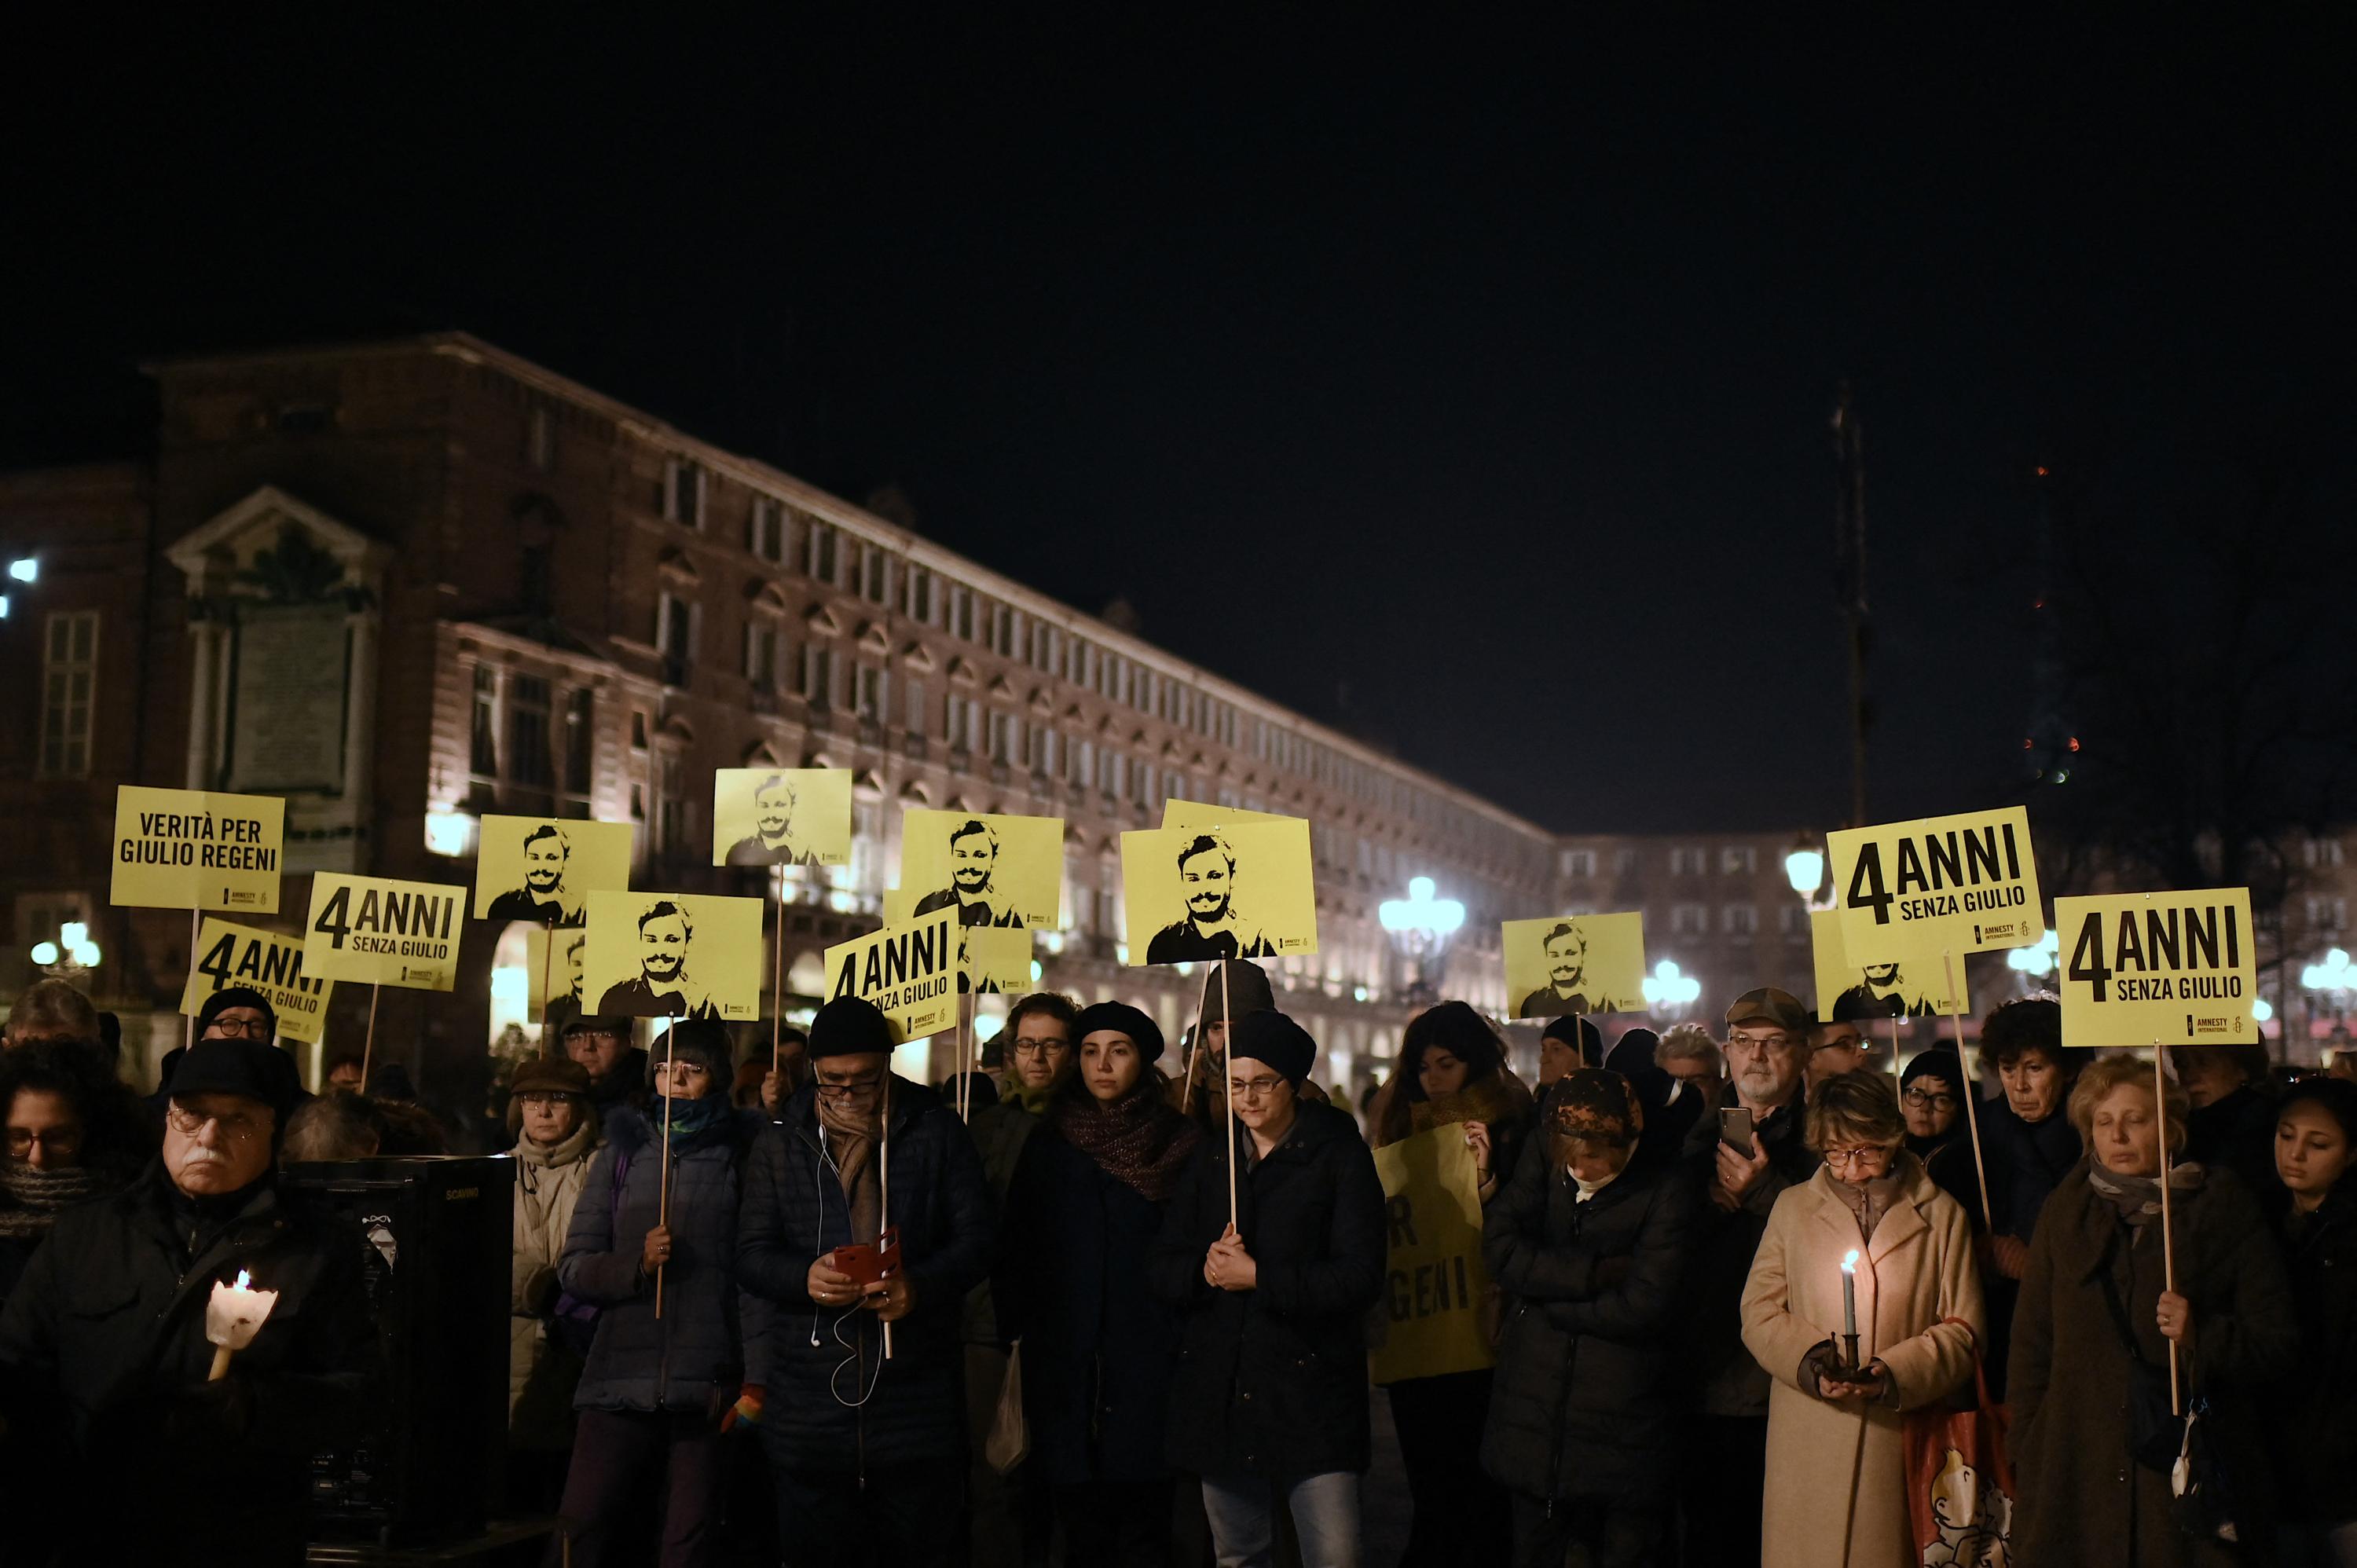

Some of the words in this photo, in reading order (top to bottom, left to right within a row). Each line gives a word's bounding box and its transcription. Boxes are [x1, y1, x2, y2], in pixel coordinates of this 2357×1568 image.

[140, 811, 215, 841] VERITÀ
[221, 819, 261, 844] PER
[120, 839, 193, 866] GIULIO
[200, 844, 276, 871] REGENI
[1846, 841, 1893, 925] 4
[1897, 823, 2022, 896] ANNI
[314, 886, 351, 949] 4
[354, 888, 454, 940] ANNI
[1901, 897, 1959, 921] SENZA
[1963, 885, 2025, 912] GIULIO
[1985, 924, 2014, 934] AMNESTY
[198, 933, 236, 991] 4
[352, 936, 396, 955] SENZA
[401, 940, 448, 959] GIULIO
[862, 921, 948, 996] ANNI
[2068, 912, 2112, 1002] 4
[2114, 905, 2241, 973] ANNI
[276, 991, 318, 1013] GIULIO
[904, 976, 948, 1005] GIULIO
[2117, 977, 2174, 1002] SENZA
[2179, 976, 2242, 999] GIULIO
[915, 1013, 936, 1024] AMNESTY
[2198, 1017, 2227, 1027] AMNESTY
